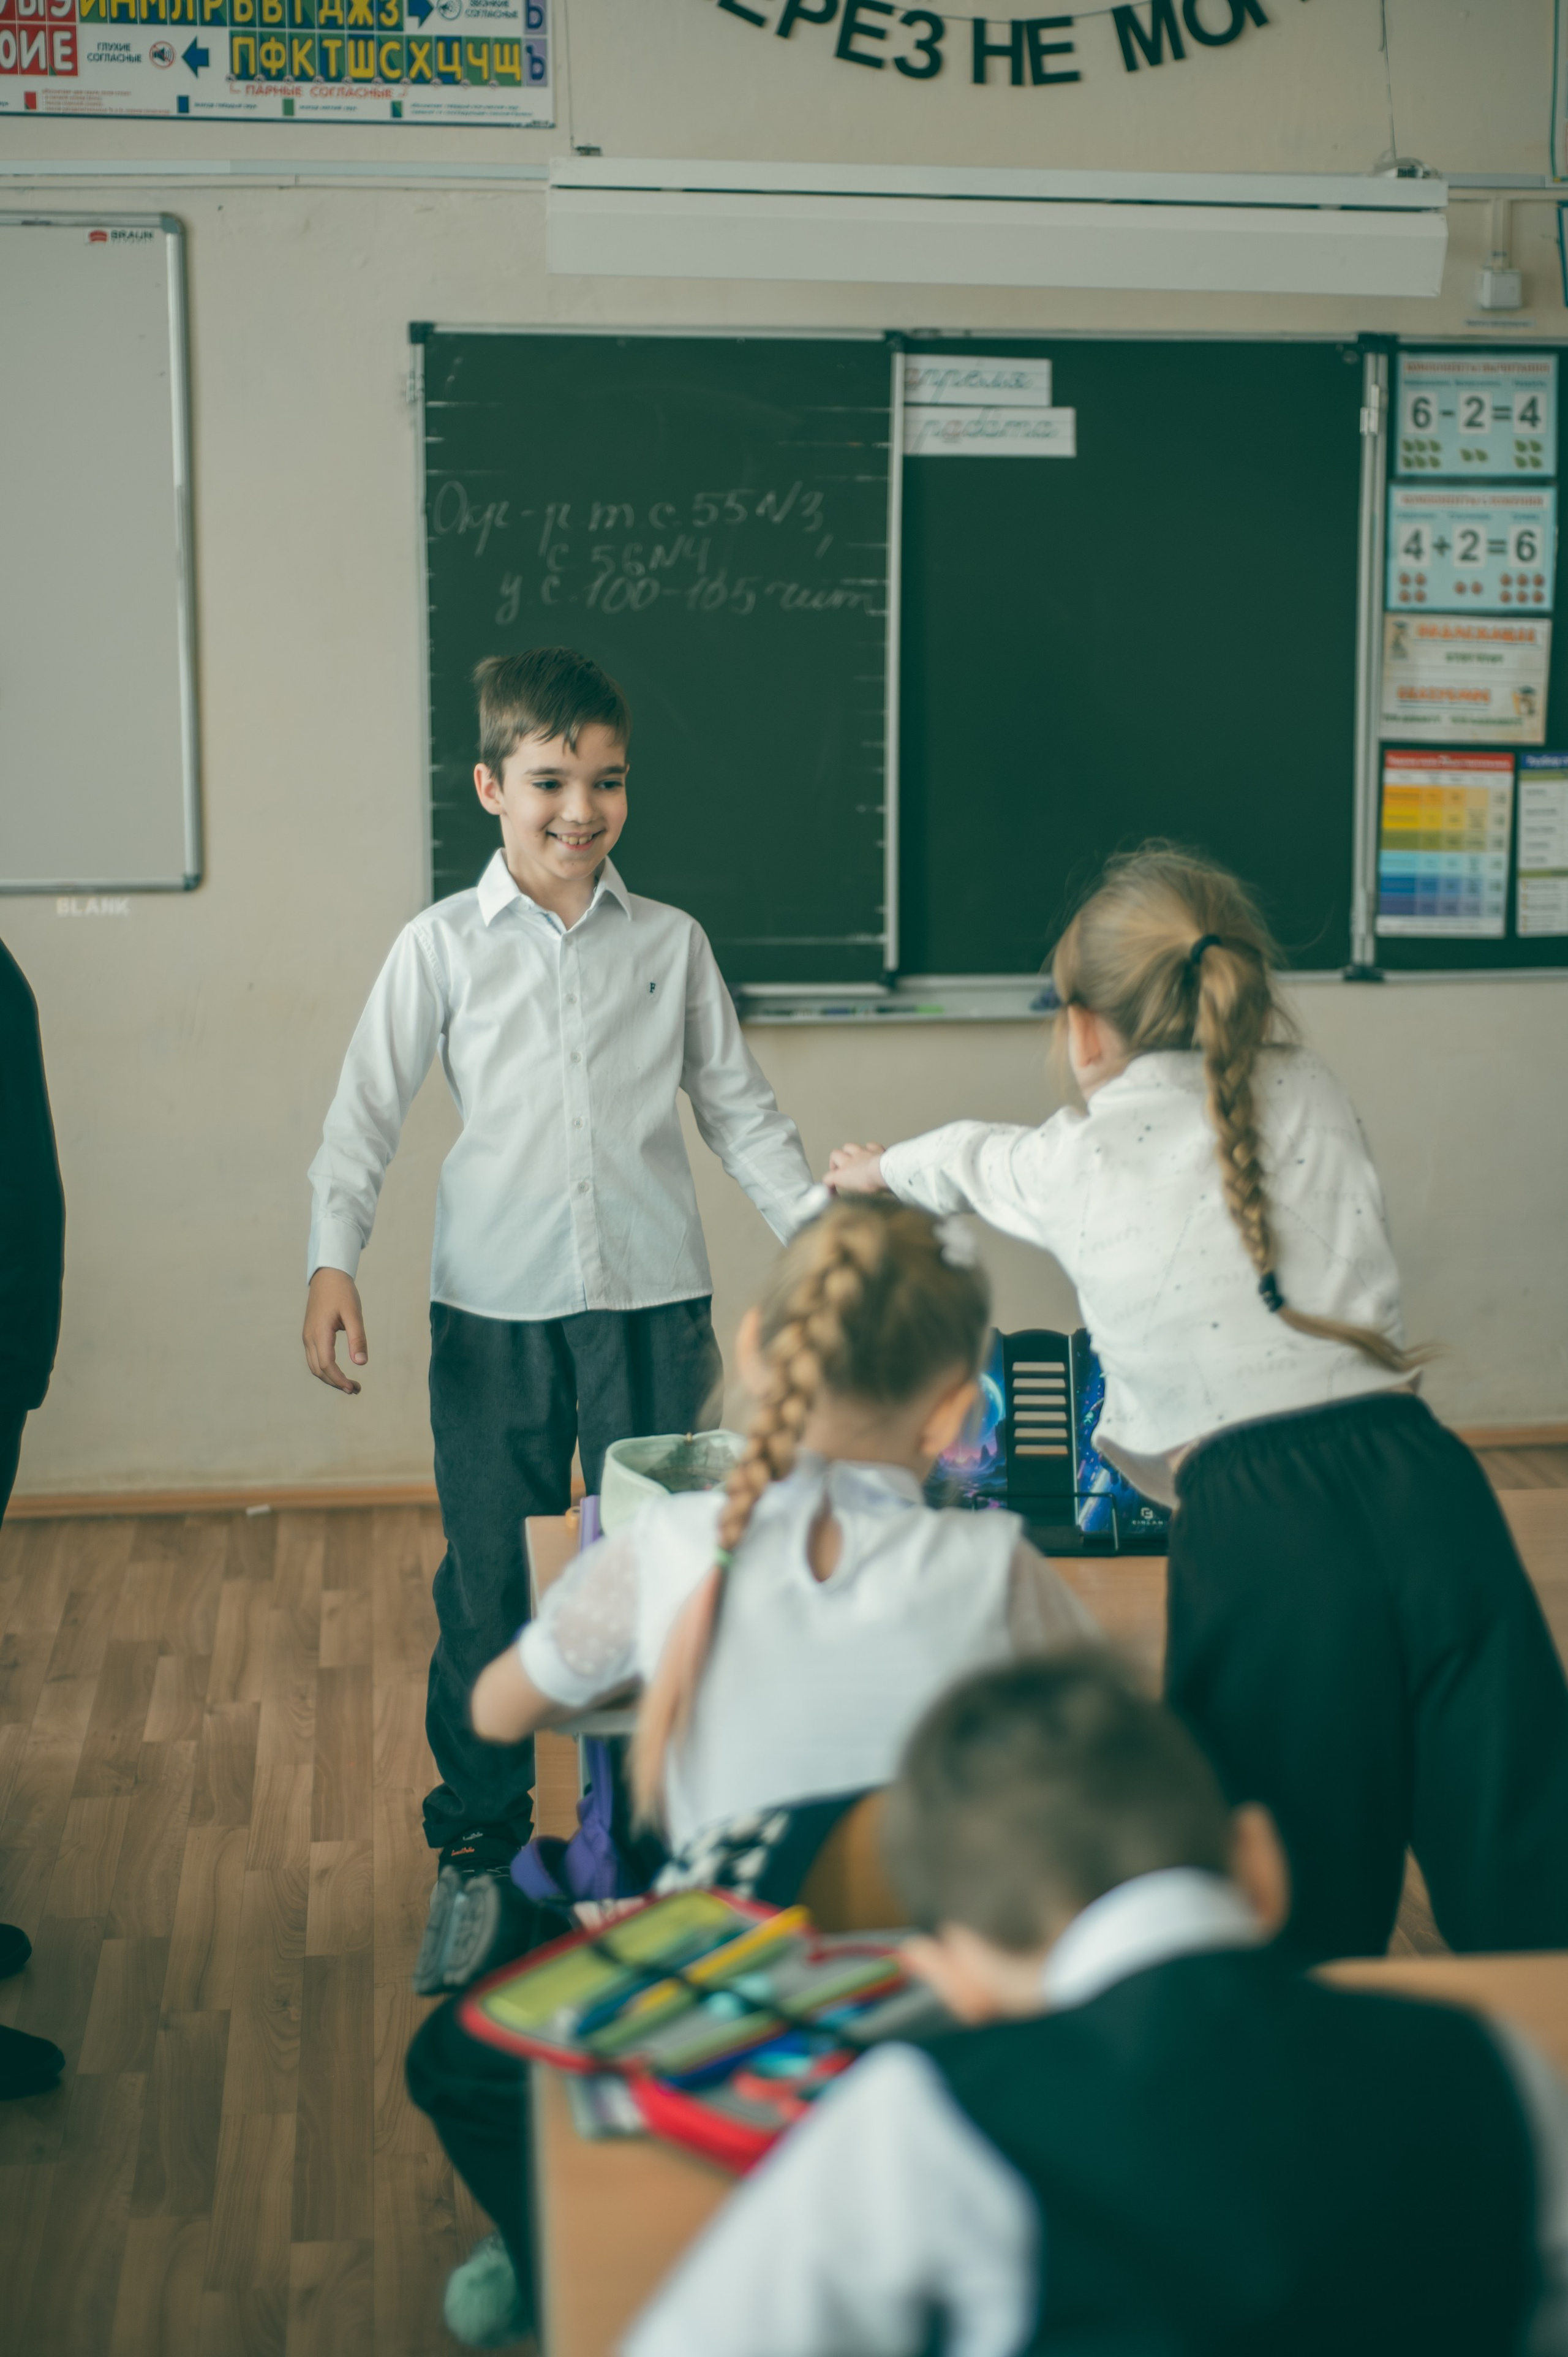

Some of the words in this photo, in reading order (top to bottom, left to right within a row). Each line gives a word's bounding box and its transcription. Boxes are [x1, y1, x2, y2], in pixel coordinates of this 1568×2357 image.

[97, 42, 130, 51] ГЛУХИЕ
[717, 0, 945, 79] РЕЗ
[972, 15, 1080, 86] НЕ
[87, 53, 141, 63] СОГЛАСНЫЕ
[246, 85, 302, 97] ПАРНЫЕ
[310, 86, 392, 99] СОГЛАСНЫЕ
[1412, 396, 1432, 429] 6
[1464, 396, 1485, 428] 2
[1519, 396, 1541, 428] 4
[1403, 529, 1425, 561] 4
[1459, 529, 1480, 562] 2
[1516, 529, 1537, 562] 6
[56, 897, 130, 917] BLANK
